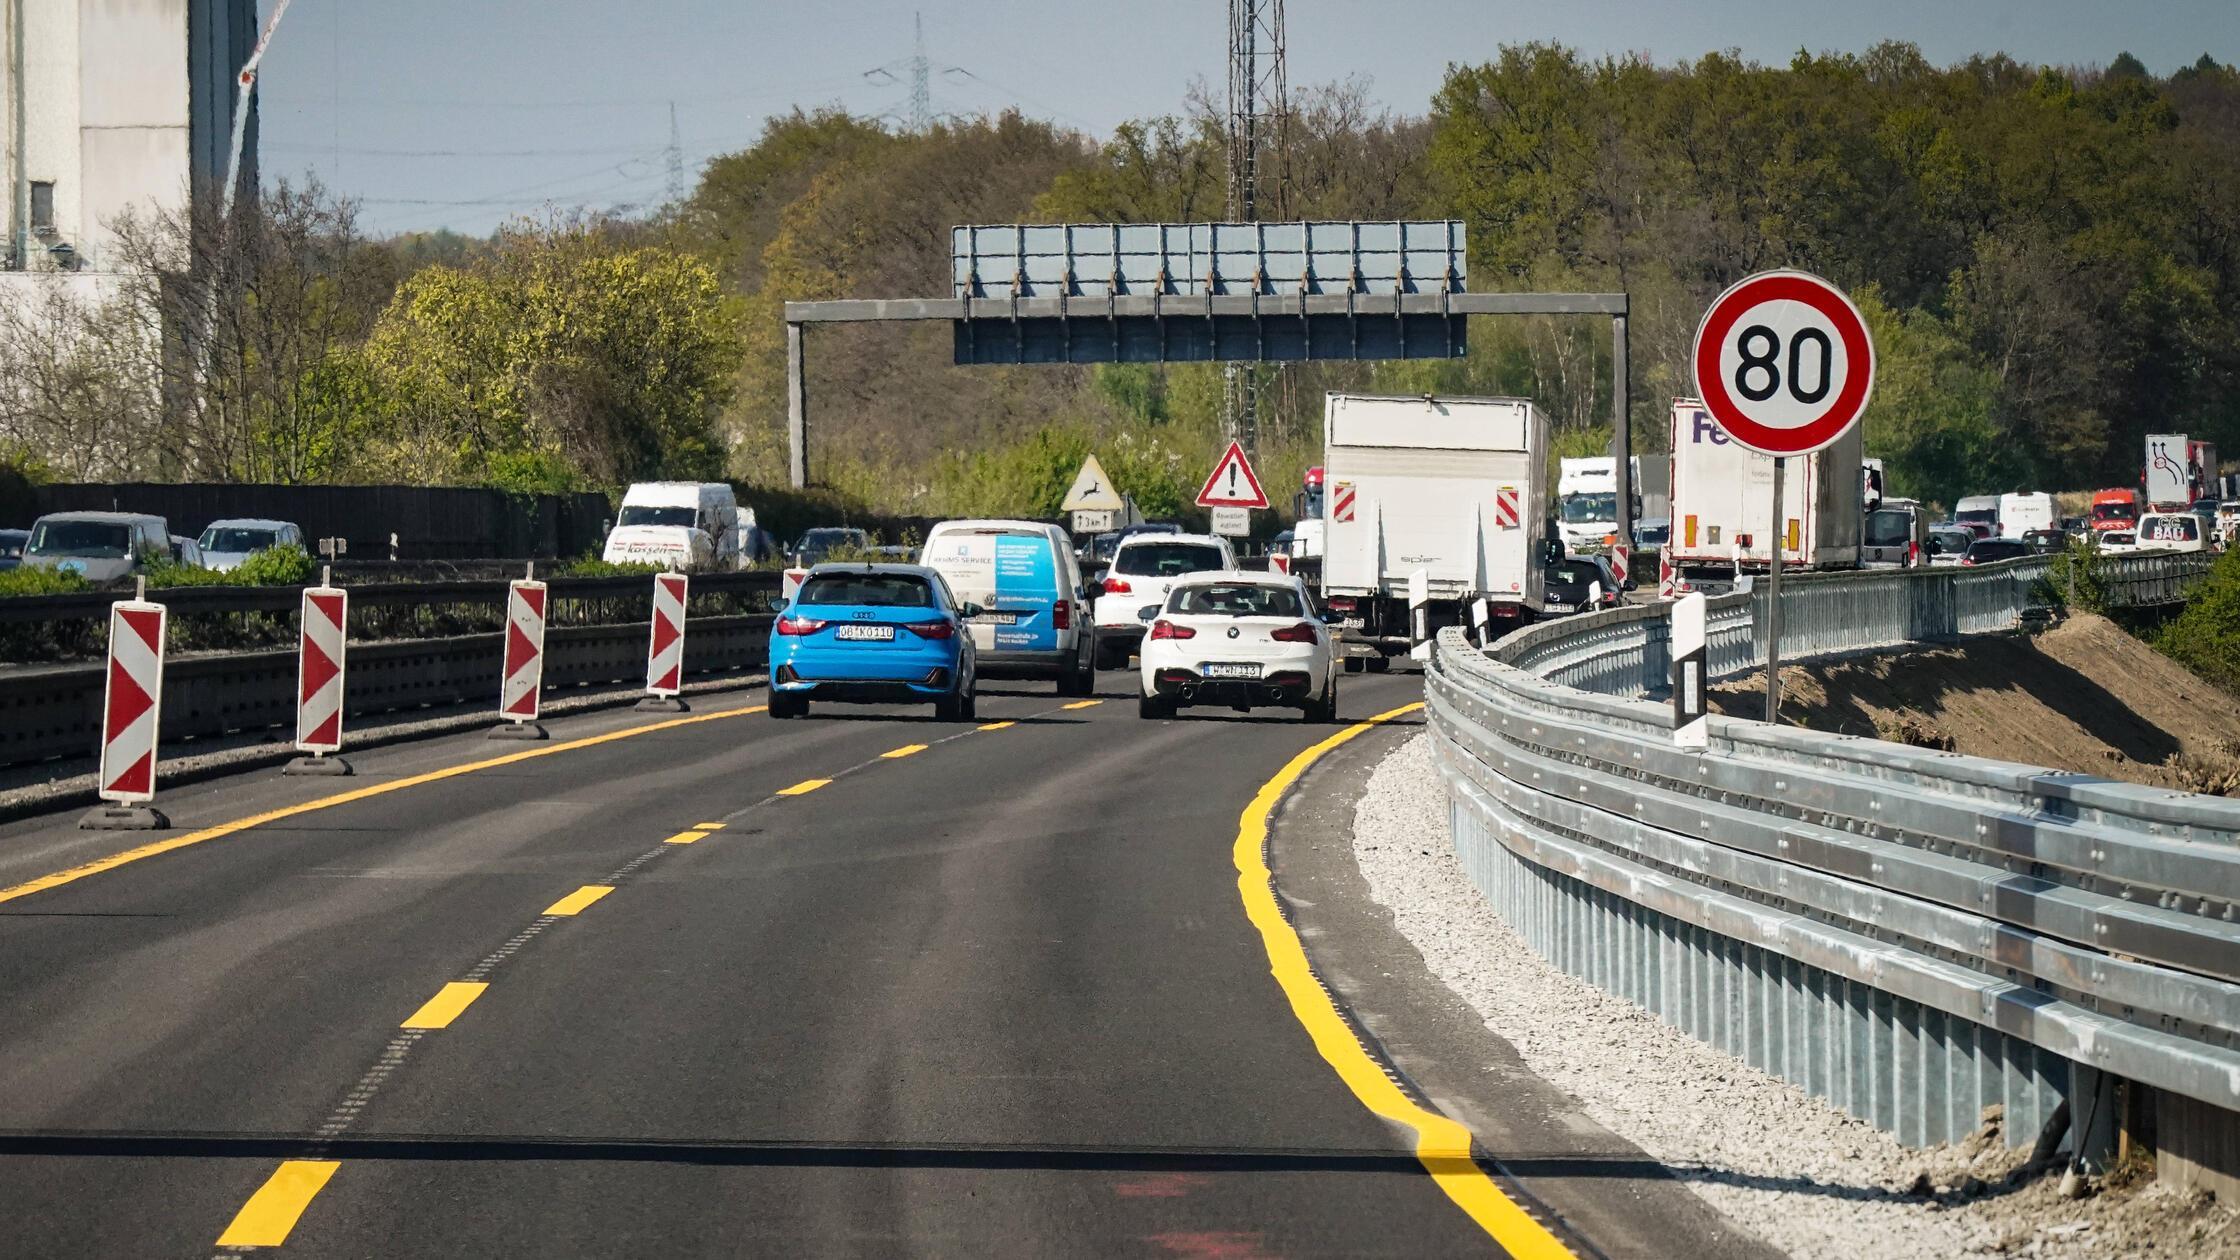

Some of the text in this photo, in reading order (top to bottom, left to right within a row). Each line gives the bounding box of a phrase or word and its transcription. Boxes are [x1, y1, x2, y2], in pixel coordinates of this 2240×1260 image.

[1735, 324, 1832, 404] 80
[1085, 516, 1090, 528] 3
[2153, 527, 2185, 541] BAU
[962, 557, 992, 565] SERVICE
